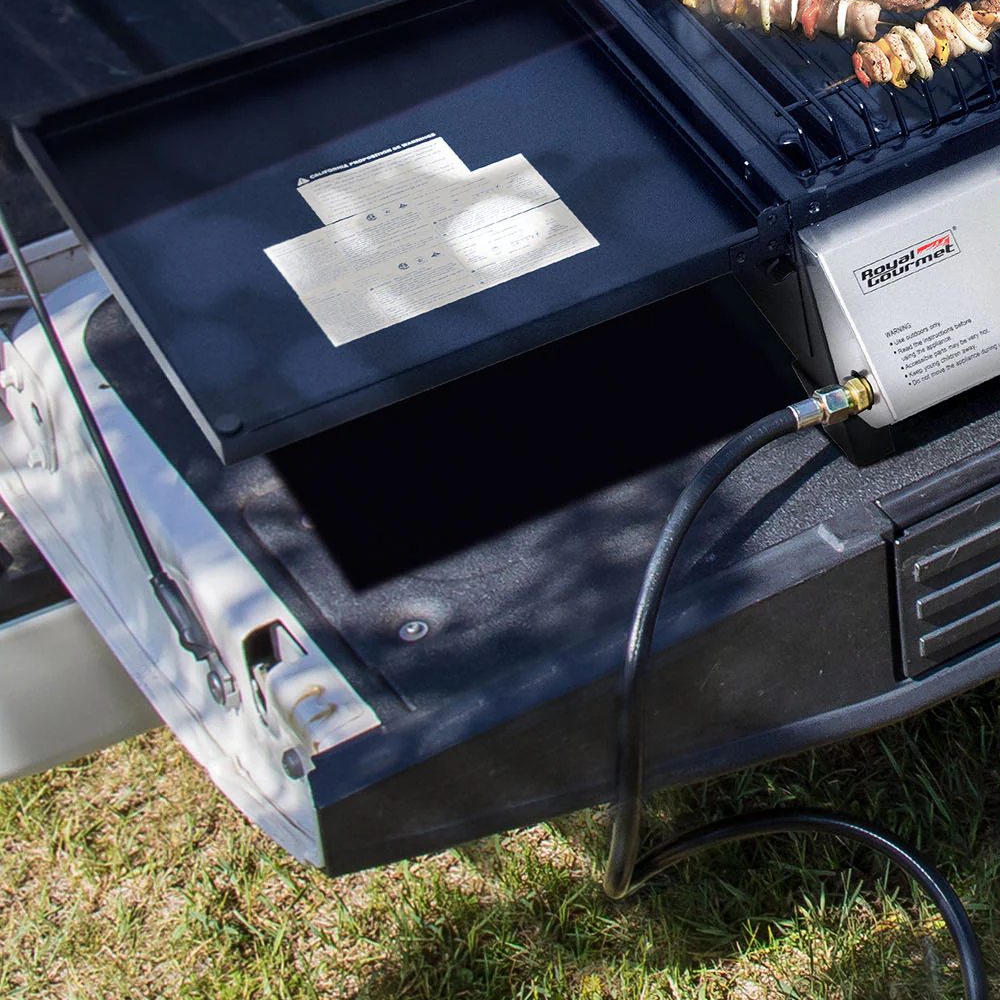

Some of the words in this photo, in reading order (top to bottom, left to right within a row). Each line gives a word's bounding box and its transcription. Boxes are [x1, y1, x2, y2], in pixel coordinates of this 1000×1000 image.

[309, 163, 349, 179] CALIFORNIA
[861, 250, 916, 281] Royal
[867, 243, 956, 288] Gourmet
[885, 322, 912, 338] WARNING
[897, 344, 913, 354] Read
[923, 326, 954, 343] instructions
[954, 318, 972, 329] before
[906, 327, 929, 340] outdoors
[901, 352, 916, 361] using
[905, 354, 933, 369] Accessible
[934, 347, 947, 357] parts
[909, 368, 923, 377] Keep
[924, 360, 941, 372] young
[941, 351, 961, 363] children
[930, 368, 946, 377] move
[956, 352, 980, 366] appliance
[981, 344, 998, 355] during
